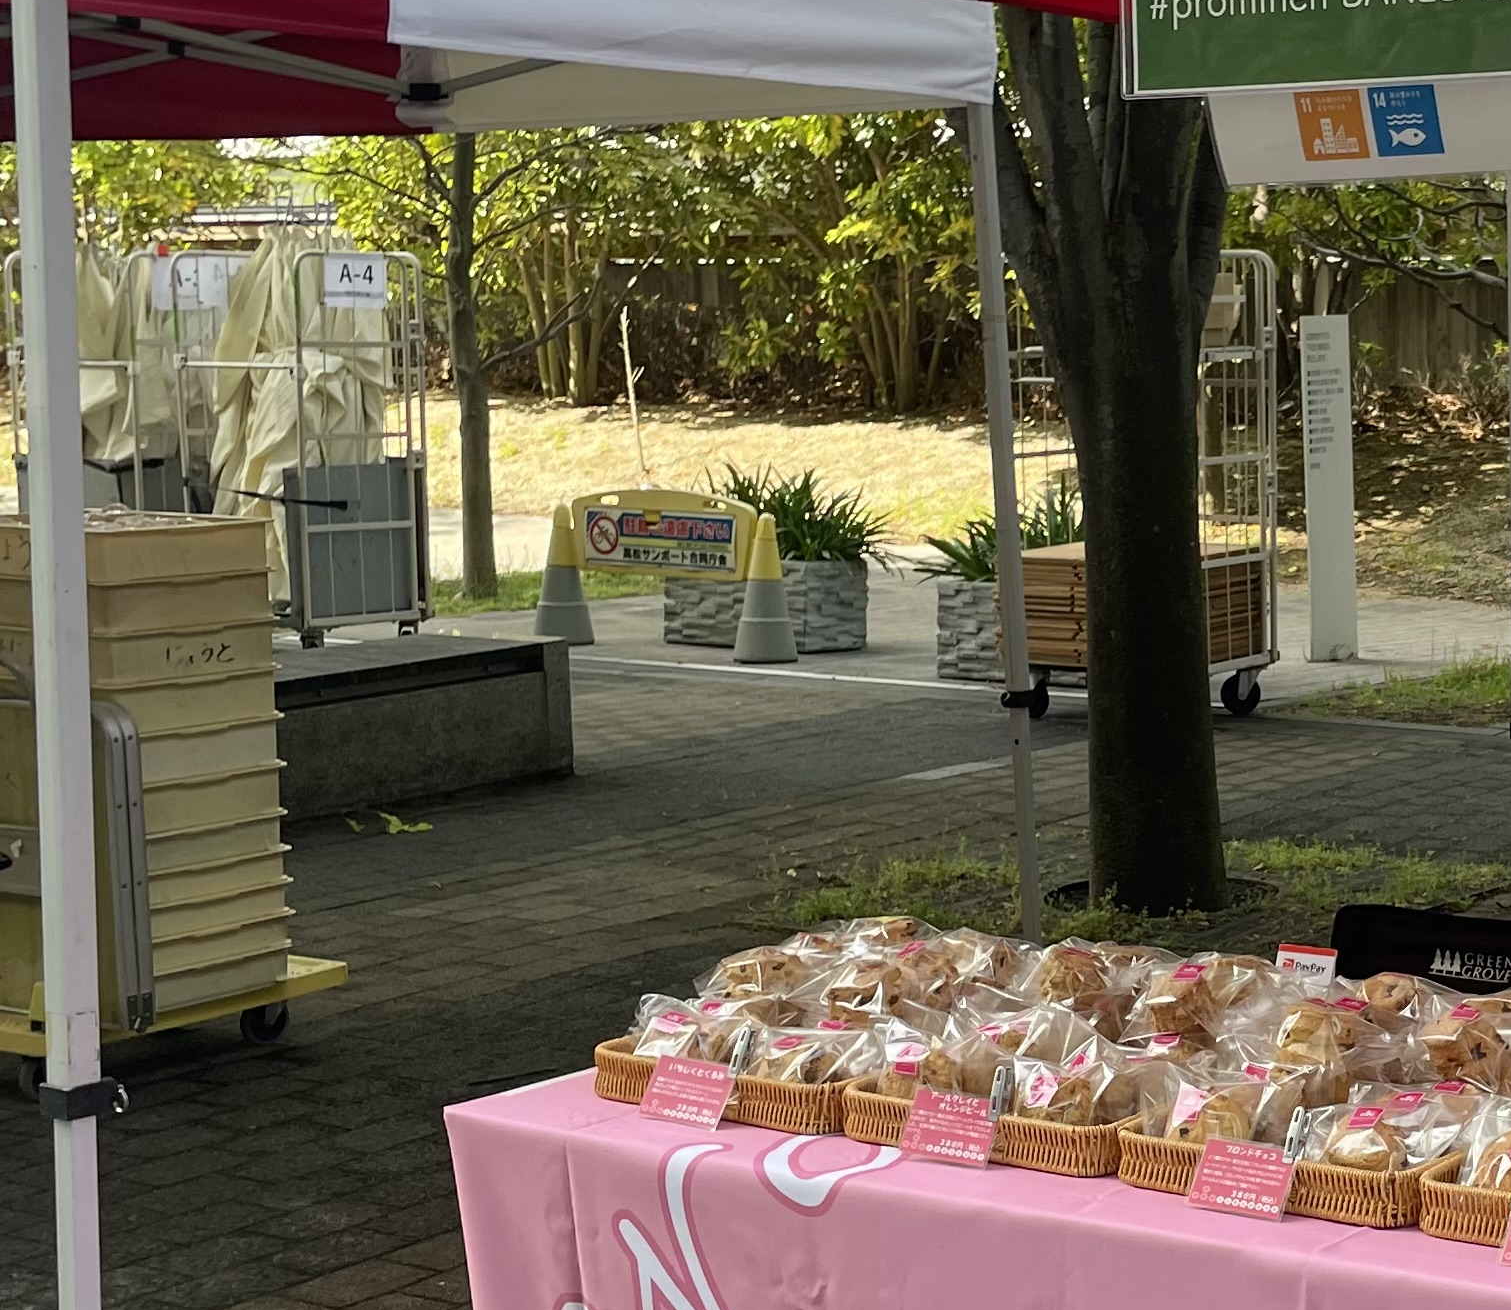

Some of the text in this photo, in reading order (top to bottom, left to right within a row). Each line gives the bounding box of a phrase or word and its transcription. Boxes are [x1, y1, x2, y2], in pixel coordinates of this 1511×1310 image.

[1300, 97, 1313, 114] 11
[1372, 91, 1387, 109] 14
[338, 262, 374, 285] A-4
[1295, 961, 1327, 975] PayPay
